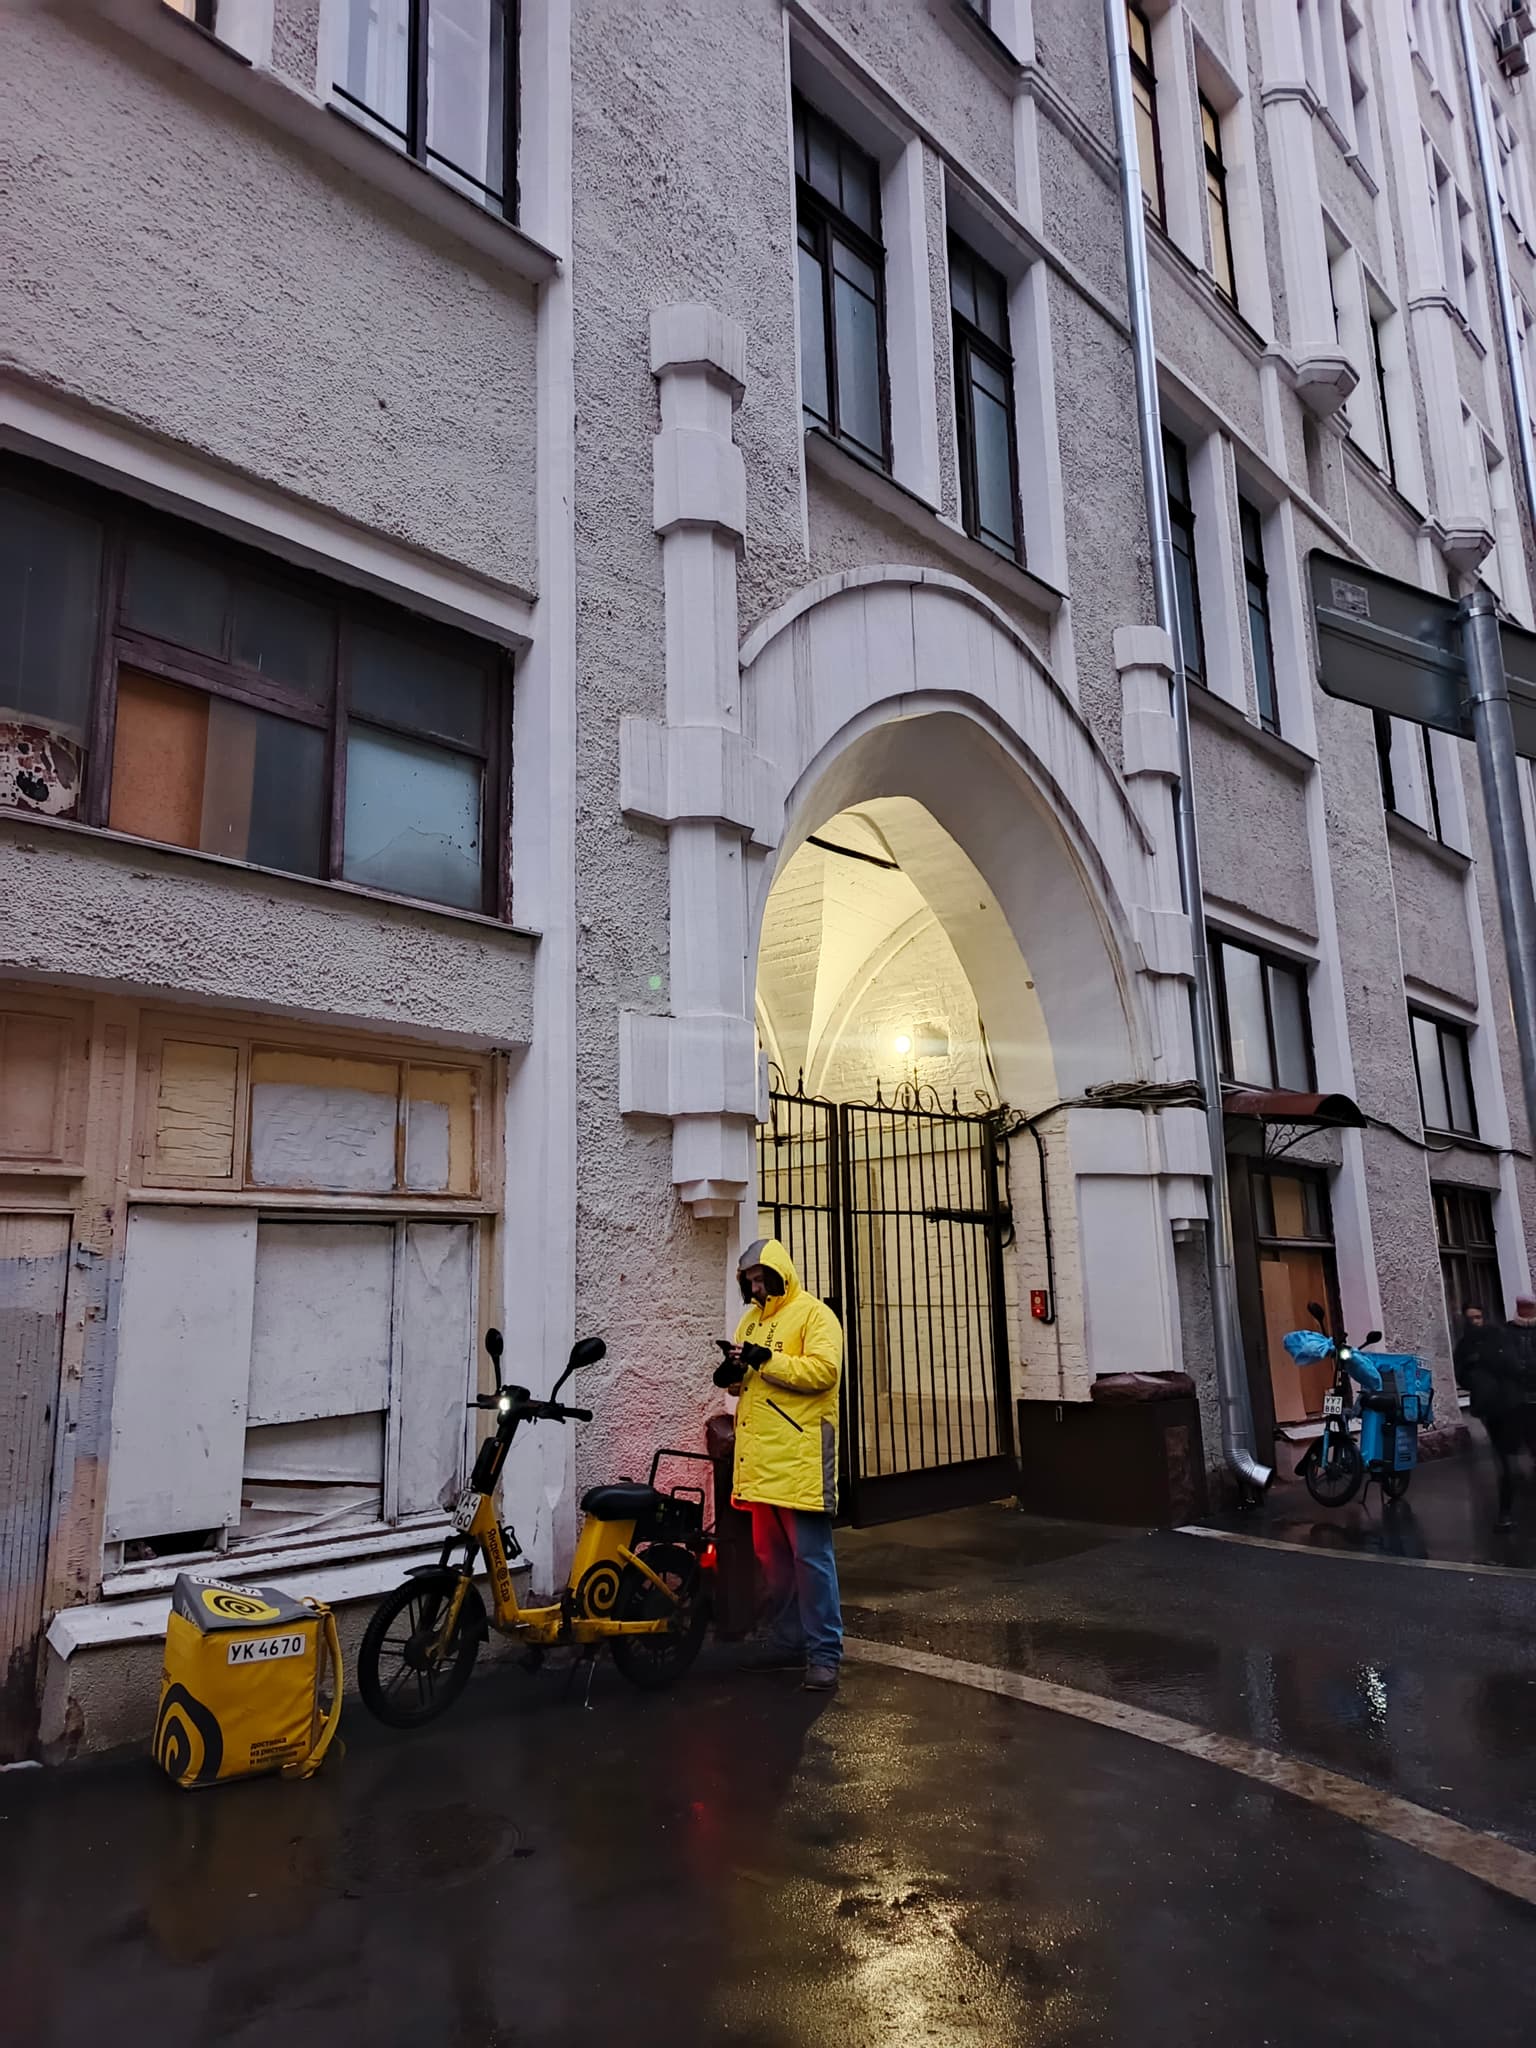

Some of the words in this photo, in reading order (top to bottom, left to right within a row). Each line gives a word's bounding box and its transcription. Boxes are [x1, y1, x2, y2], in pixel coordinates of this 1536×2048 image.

[764, 1321, 778, 1347] декс
[454, 1511, 472, 1528] 760
[487, 1528, 502, 1568] Яндекс
[500, 1581, 511, 1602] Еда
[231, 1642, 255, 1661] УК
[259, 1637, 301, 1657] 4670
